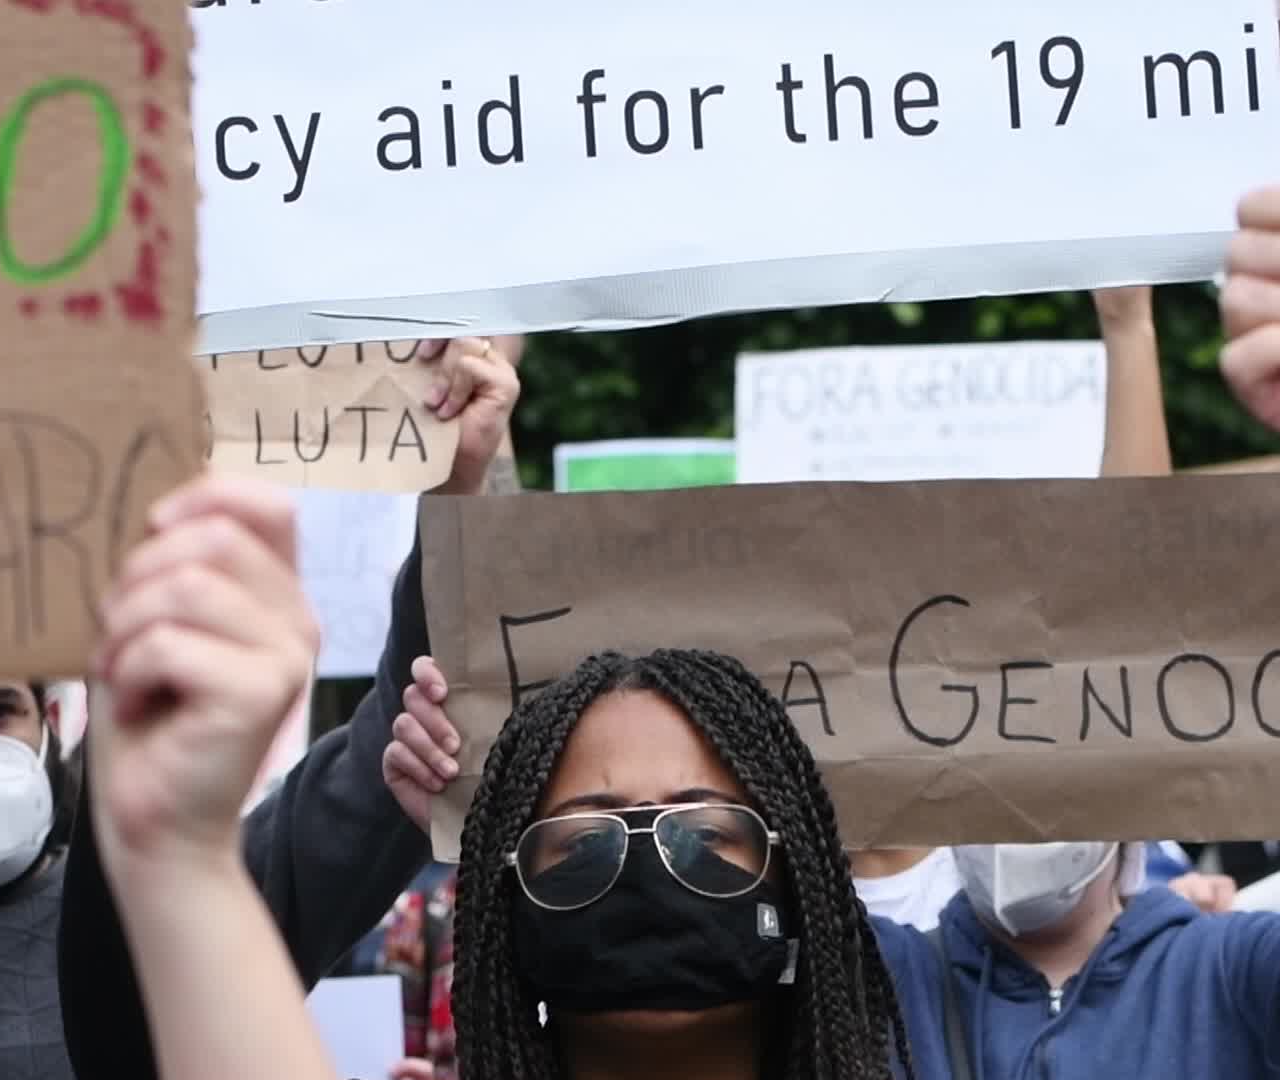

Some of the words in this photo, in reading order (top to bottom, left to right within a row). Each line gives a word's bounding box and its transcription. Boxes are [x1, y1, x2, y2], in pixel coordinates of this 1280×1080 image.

[214, 116, 320, 202] cy
[376, 75, 524, 170] aid
[576, 69, 725, 158] for
[775, 53, 940, 144] the
[988, 36, 1086, 132] 19
[255, 405, 427, 465] LUTA
[498, 604, 836, 738] FA
